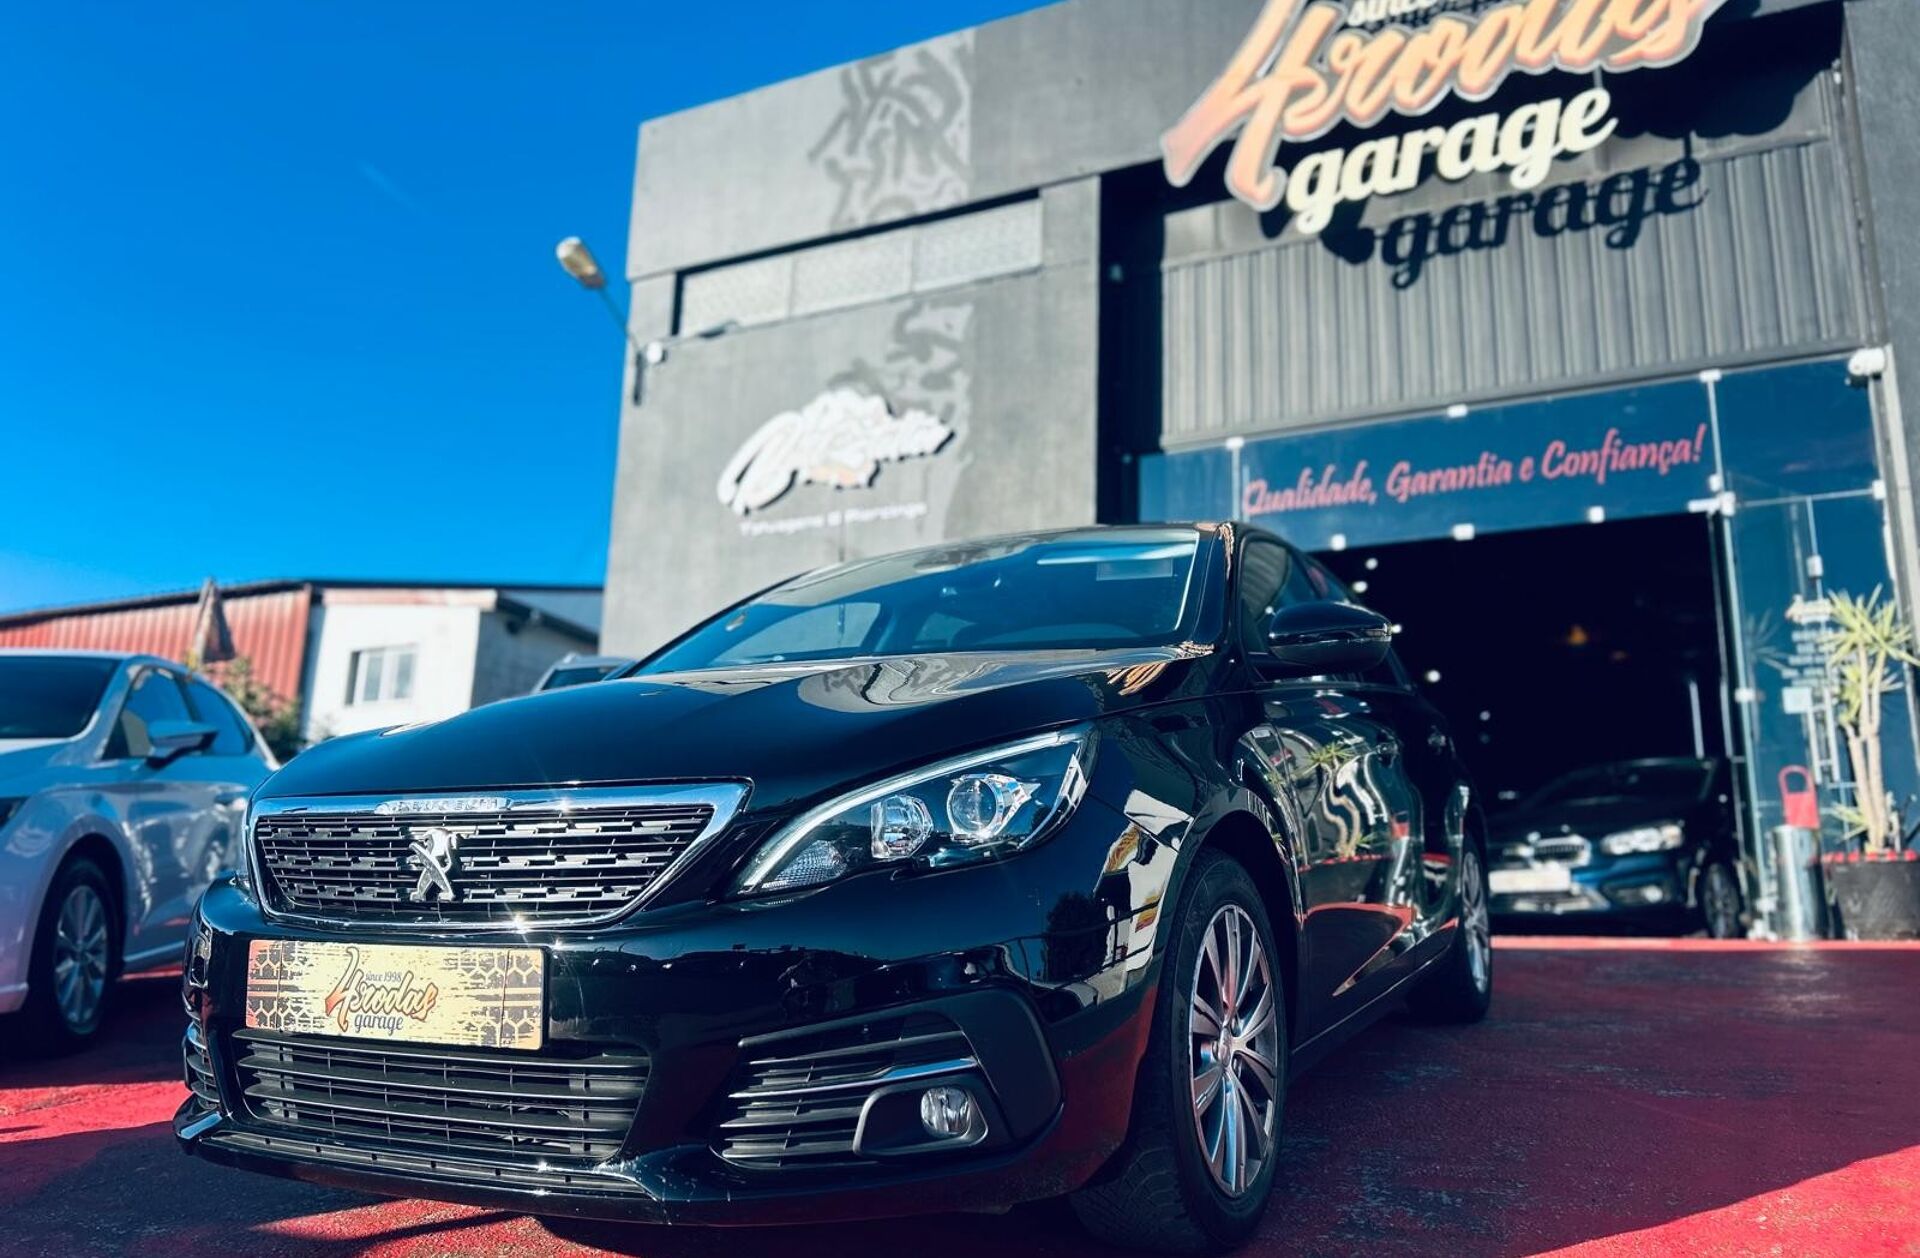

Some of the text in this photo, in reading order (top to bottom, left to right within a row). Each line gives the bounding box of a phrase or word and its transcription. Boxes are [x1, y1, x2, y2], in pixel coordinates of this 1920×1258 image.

[1287, 87, 1619, 234] garage
[1382, 156, 1710, 290] garage
[1241, 423, 1707, 517] Qualidade, Garantia e Confiança!
[365, 971, 383, 982] since
[353, 1013, 405, 1036] garage
